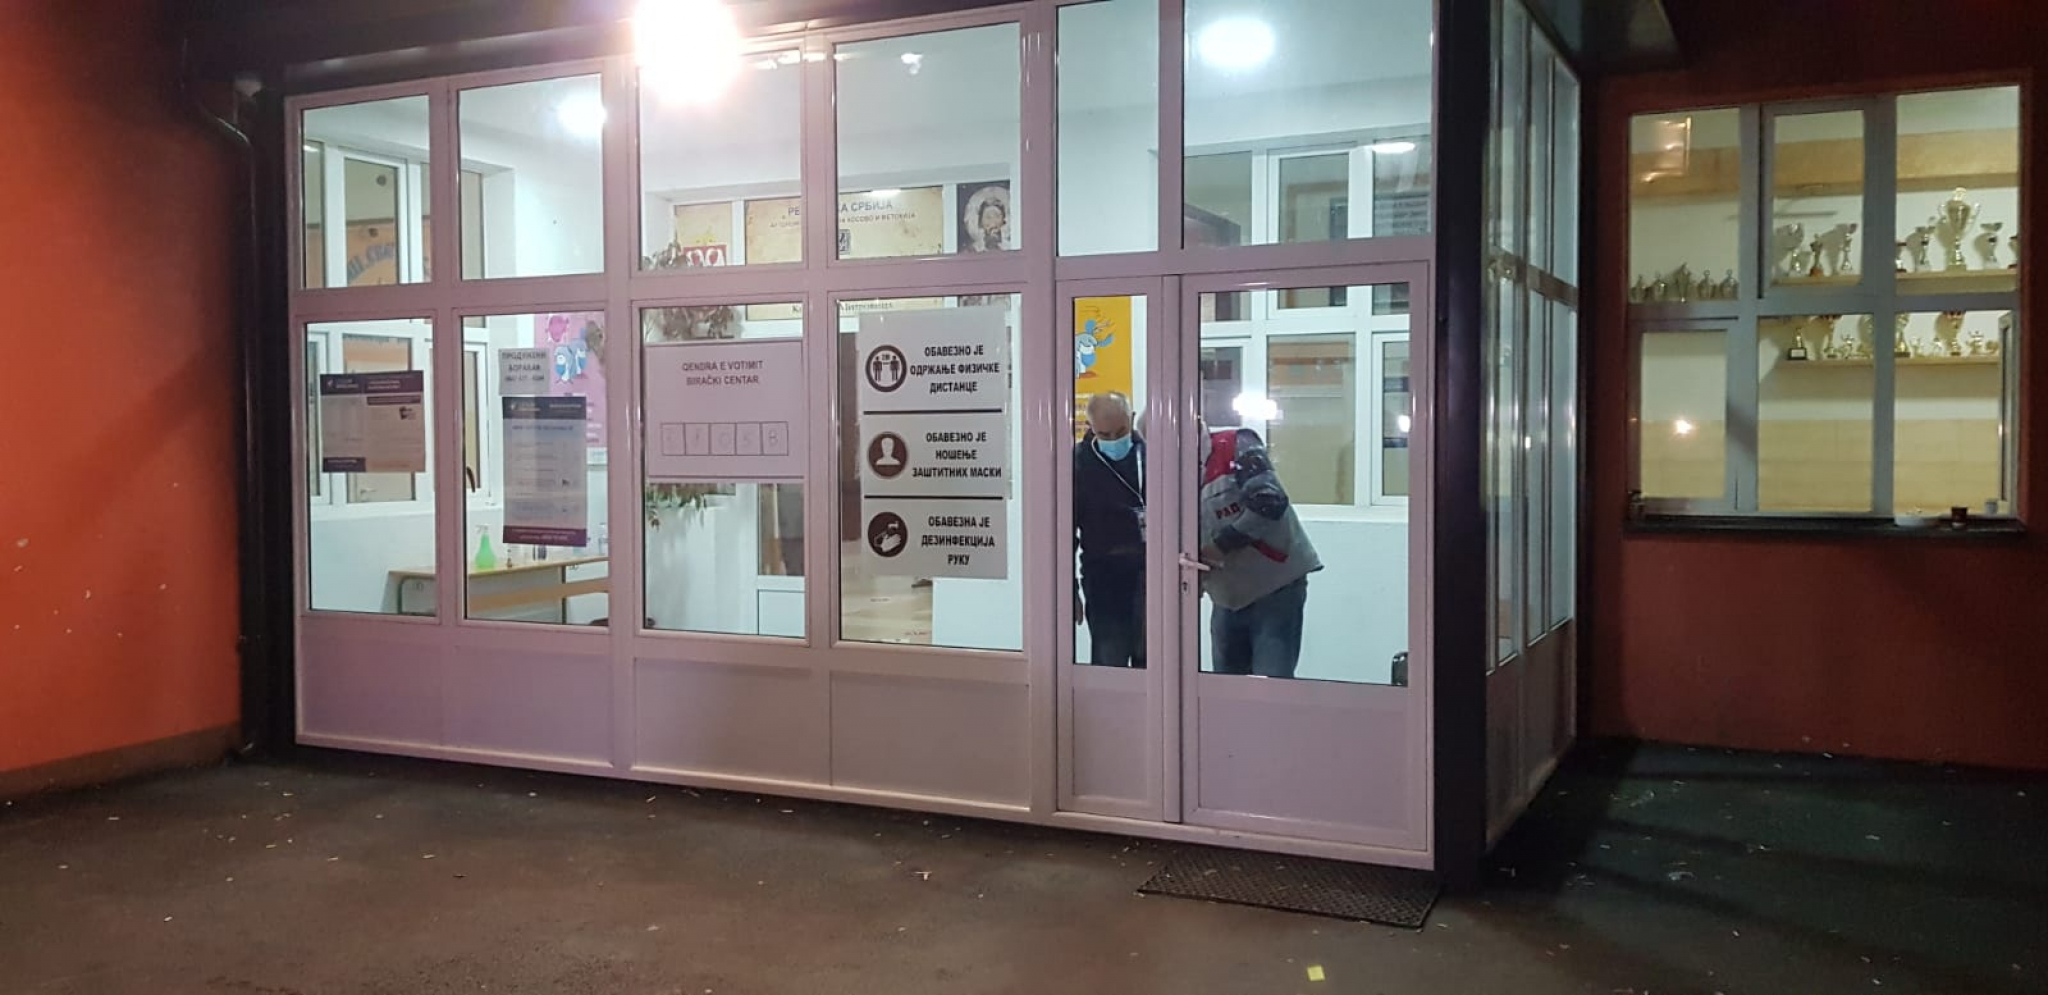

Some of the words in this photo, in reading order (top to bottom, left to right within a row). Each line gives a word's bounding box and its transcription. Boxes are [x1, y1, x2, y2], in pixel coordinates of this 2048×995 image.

[851, 200, 893, 212] СРБИЈА
[924, 345, 971, 357] ОБАВЕЗНО
[973, 344, 984, 356] ЈЕ
[682, 361, 718, 371] QENDRA
[720, 360, 727, 370] E
[727, 360, 764, 370] VOTIMIT
[910, 363, 956, 377] ОДРЖАЊЕ
[958, 362, 1000, 374] ФИЗИЧКЕ
[686, 375, 721, 386] BIRAČKI
[724, 375, 759, 385] CENTAR
[930, 381, 978, 395] ДИСТАНЦЕ
[926, 431, 974, 443] ОБАВЕЗНО
[975, 430, 987, 442] ЈЕ
[936, 449, 978, 461] НОШЕЊЕ
[912, 467, 969, 479] ЗАШТИТНИХ
[970, 466, 1003, 479] МАСКИ
[928, 515, 977, 528] ОБАВЕЗНА
[978, 515, 991, 528] ЈЕ
[921, 534, 996, 549] ДЕЗИНФЕКЦИЈА
[948, 554, 971, 566] РУКУ
